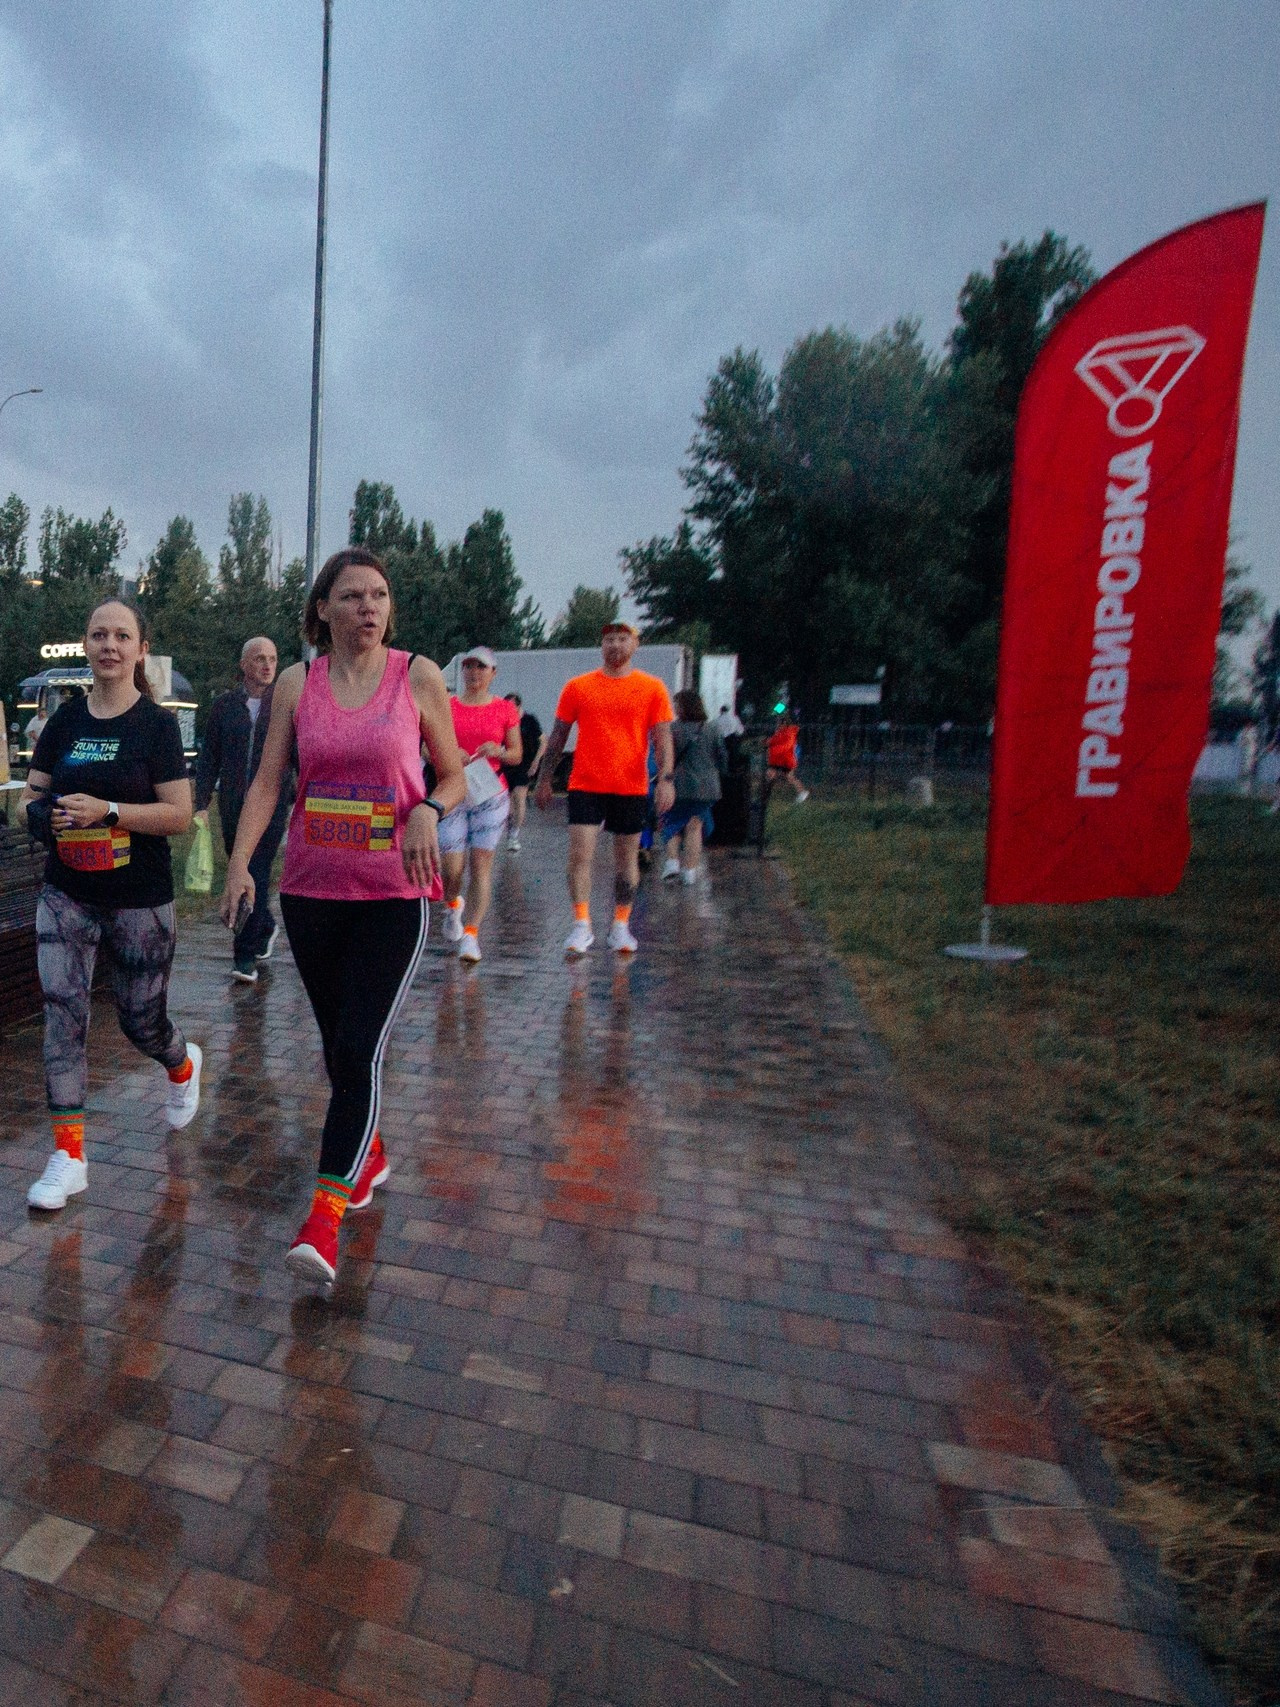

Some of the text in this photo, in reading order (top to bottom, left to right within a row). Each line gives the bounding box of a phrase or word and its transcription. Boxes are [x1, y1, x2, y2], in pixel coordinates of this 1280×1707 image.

[1075, 440, 1153, 797] ГРАВИРОВКА
[41, 643, 86, 658] COFFE
[75, 742, 119, 751] RUN THE
[70, 751, 116, 761] DISTANCE
[310, 818, 367, 844] 5880
